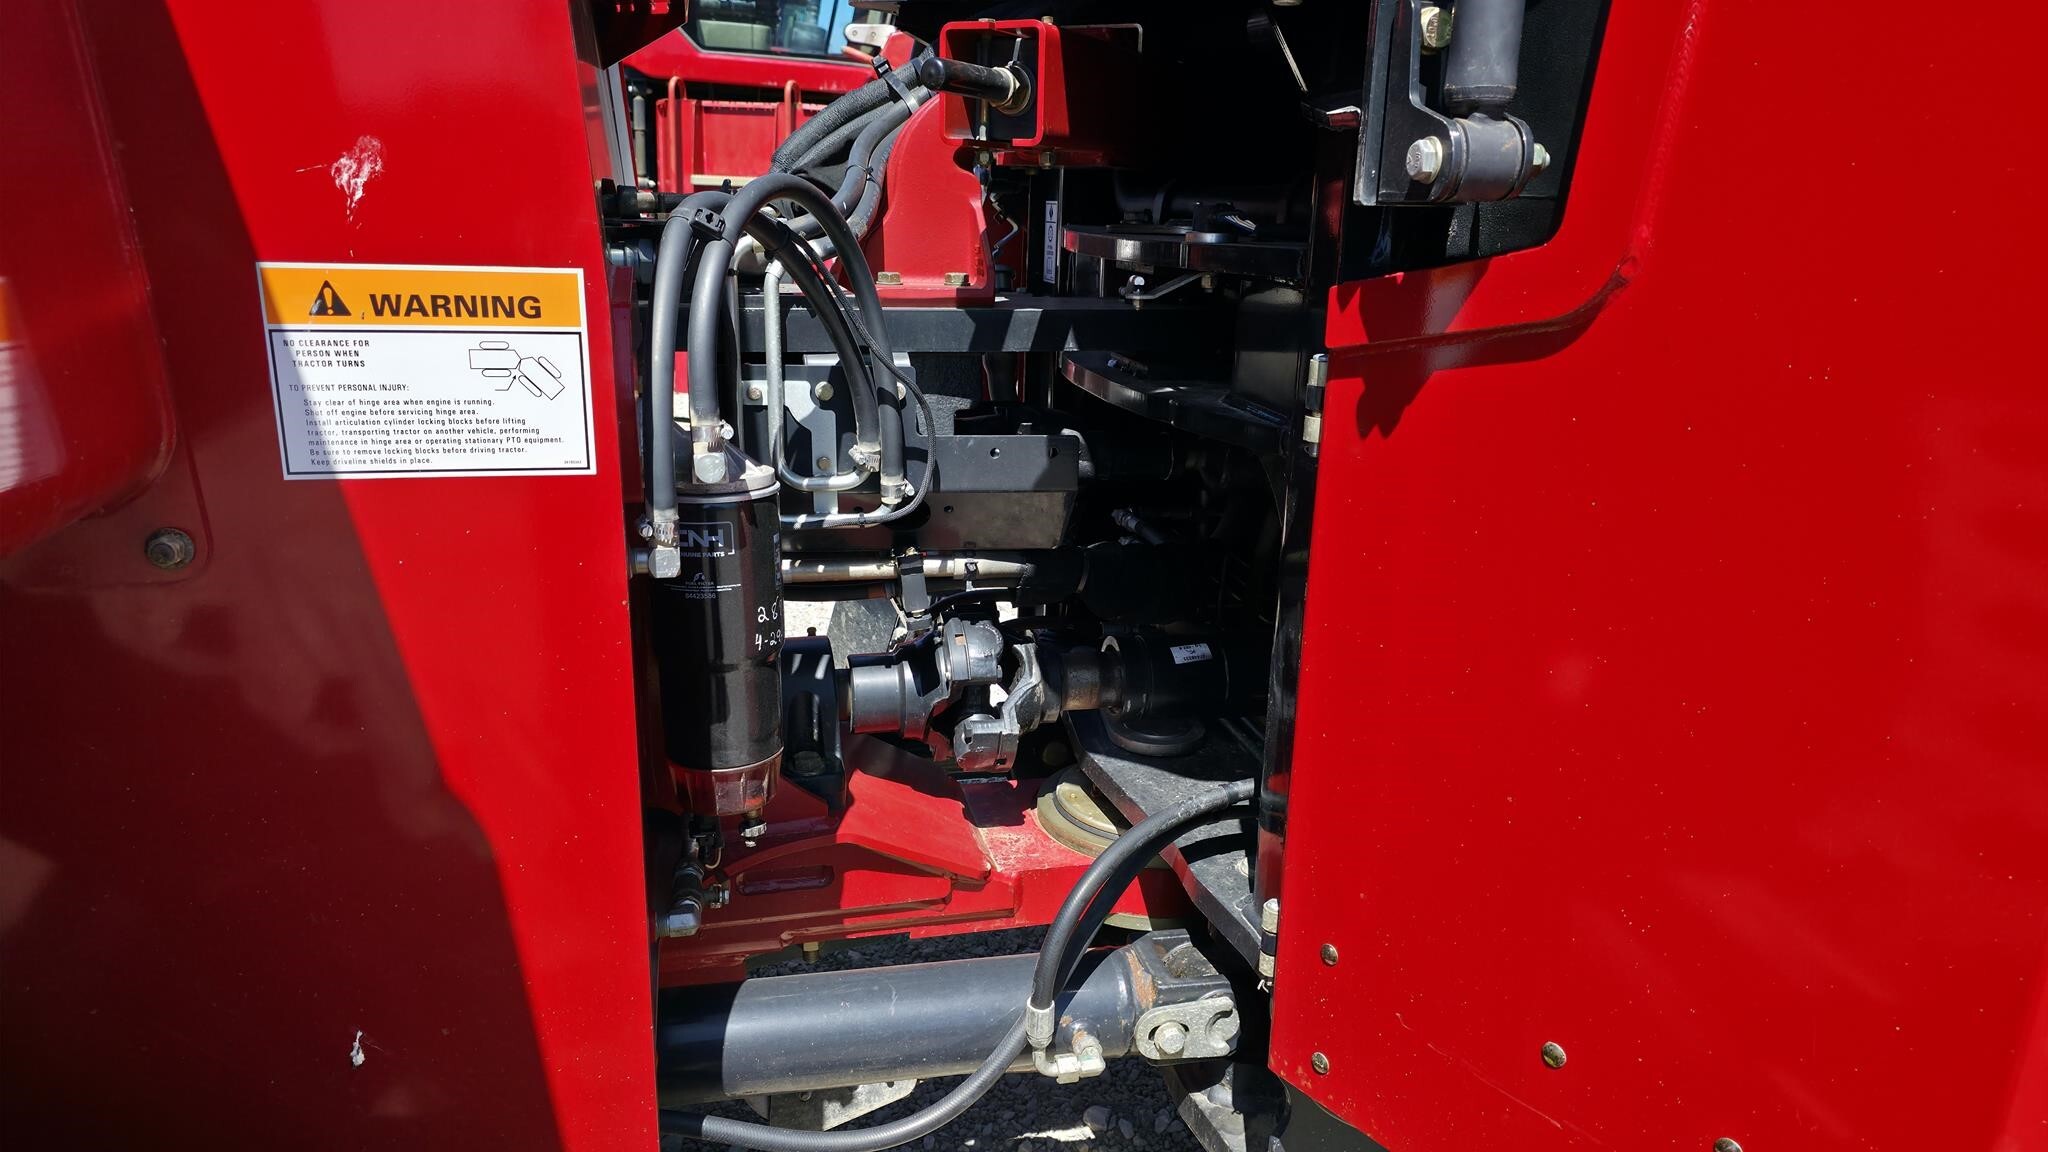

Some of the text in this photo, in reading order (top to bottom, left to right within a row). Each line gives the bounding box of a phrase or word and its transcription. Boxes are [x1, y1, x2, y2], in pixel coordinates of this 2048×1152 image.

[369, 294, 542, 319] WARNING
[283, 339, 370, 348] NO CLEARANCE FOR
[296, 349, 330, 357] PERSON
[292, 360, 365, 368] TRACTOR TURNS
[304, 399, 321, 407] Stay
[359, 399, 380, 407] hinge
[464, 399, 495, 407] running.
[341, 409, 366, 417] engine
[398, 409, 433, 417] servicing
[436, 408, 456, 416] hinge
[384, 419, 415, 427] cylinder
[502, 418, 526, 426] lifting
[307, 429, 338, 437] tractor,
[341, 429, 390, 437] transporting
[500, 427, 540, 435] performing
[371, 439, 392, 447] hinge
[426, 438, 462, 446] operating
[465, 437, 503, 445] stationary
[524, 437, 564, 445] equipment.
[384, 448, 412, 456] locking
[470, 447, 496, 455] driving
[311, 459, 330, 467] Keep
[410, 457, 432, 465] place.
